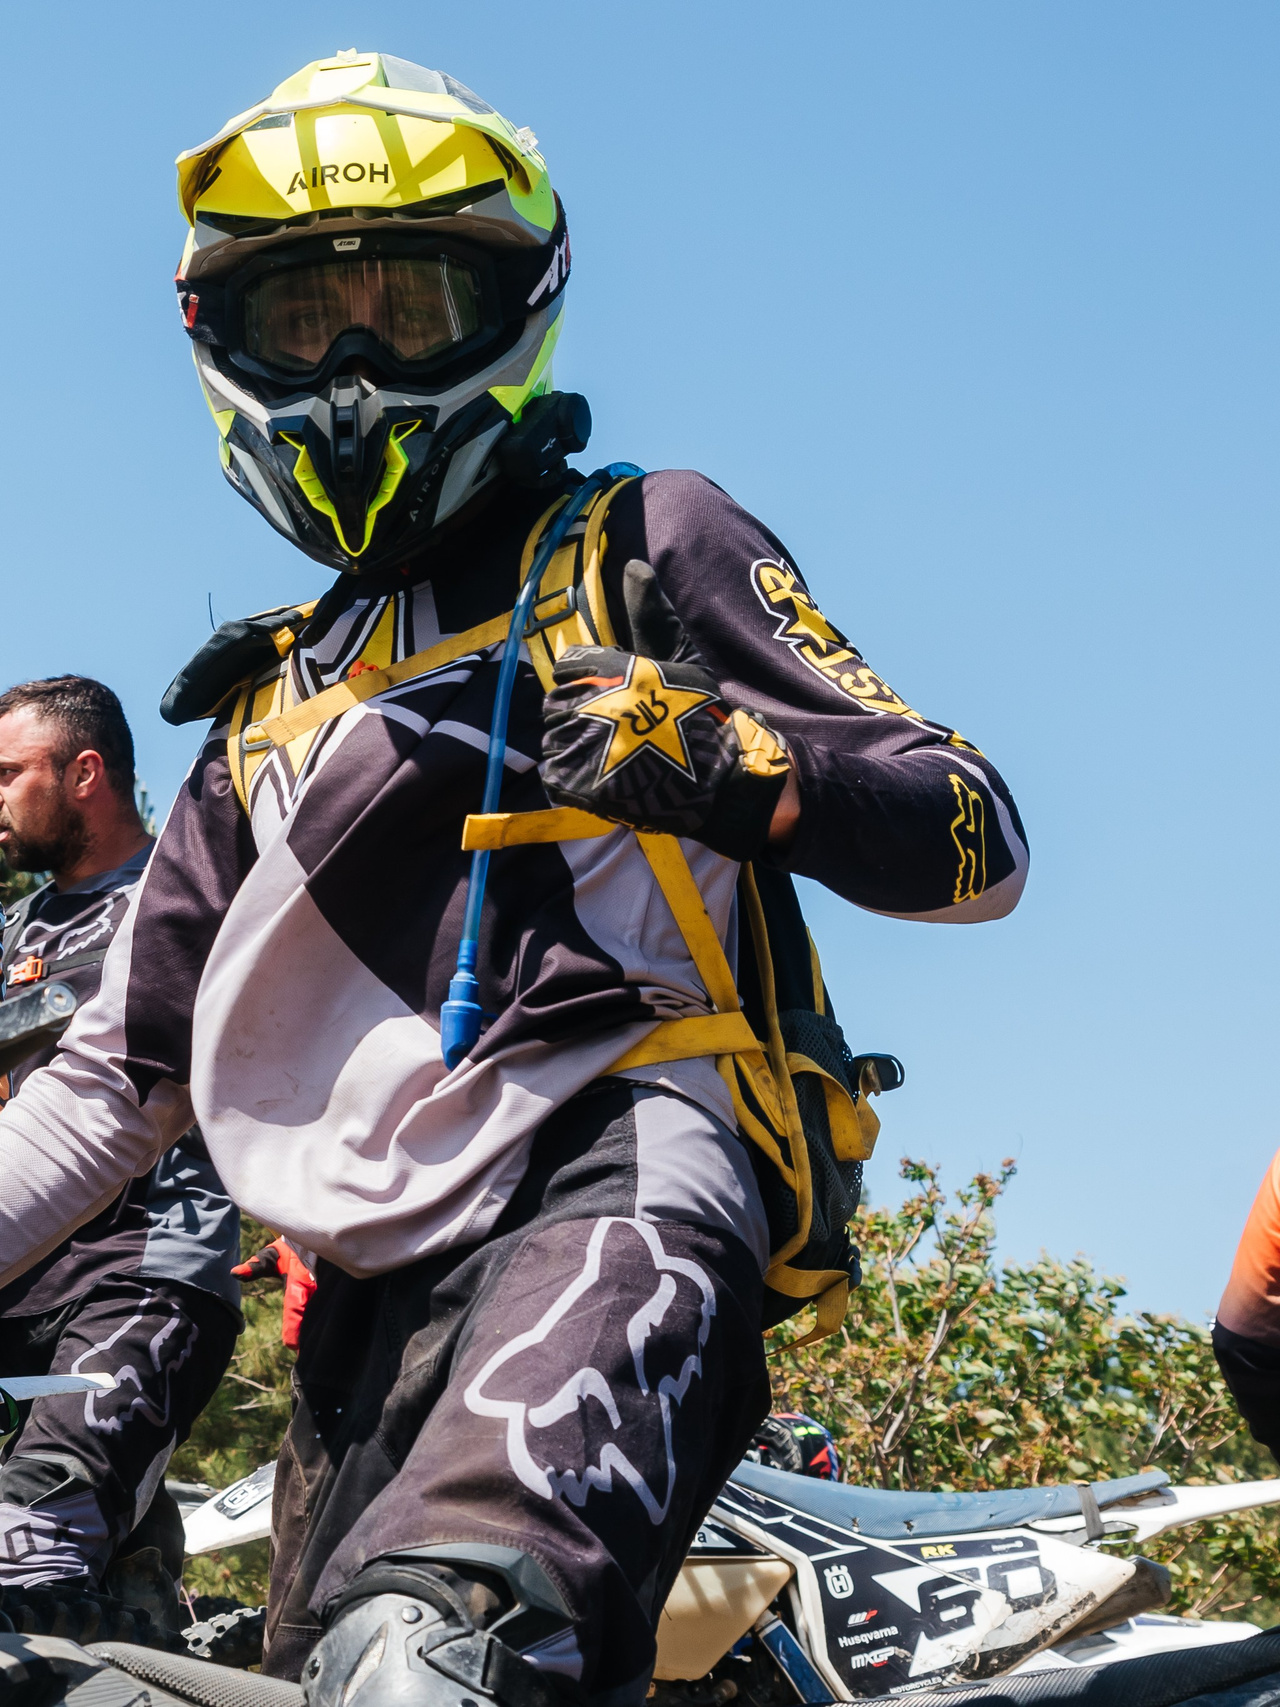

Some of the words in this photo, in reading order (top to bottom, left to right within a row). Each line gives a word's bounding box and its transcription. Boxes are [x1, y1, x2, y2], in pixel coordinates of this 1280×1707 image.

[286, 162, 389, 195] AIROH
[409, 446, 450, 522] AIROH
[920, 1543, 958, 1560] RK
[838, 1625, 899, 1648] Husqvarna
[850, 1646, 896, 1670] MXGP
[889, 1676, 943, 1694] MOTORCYCLES
